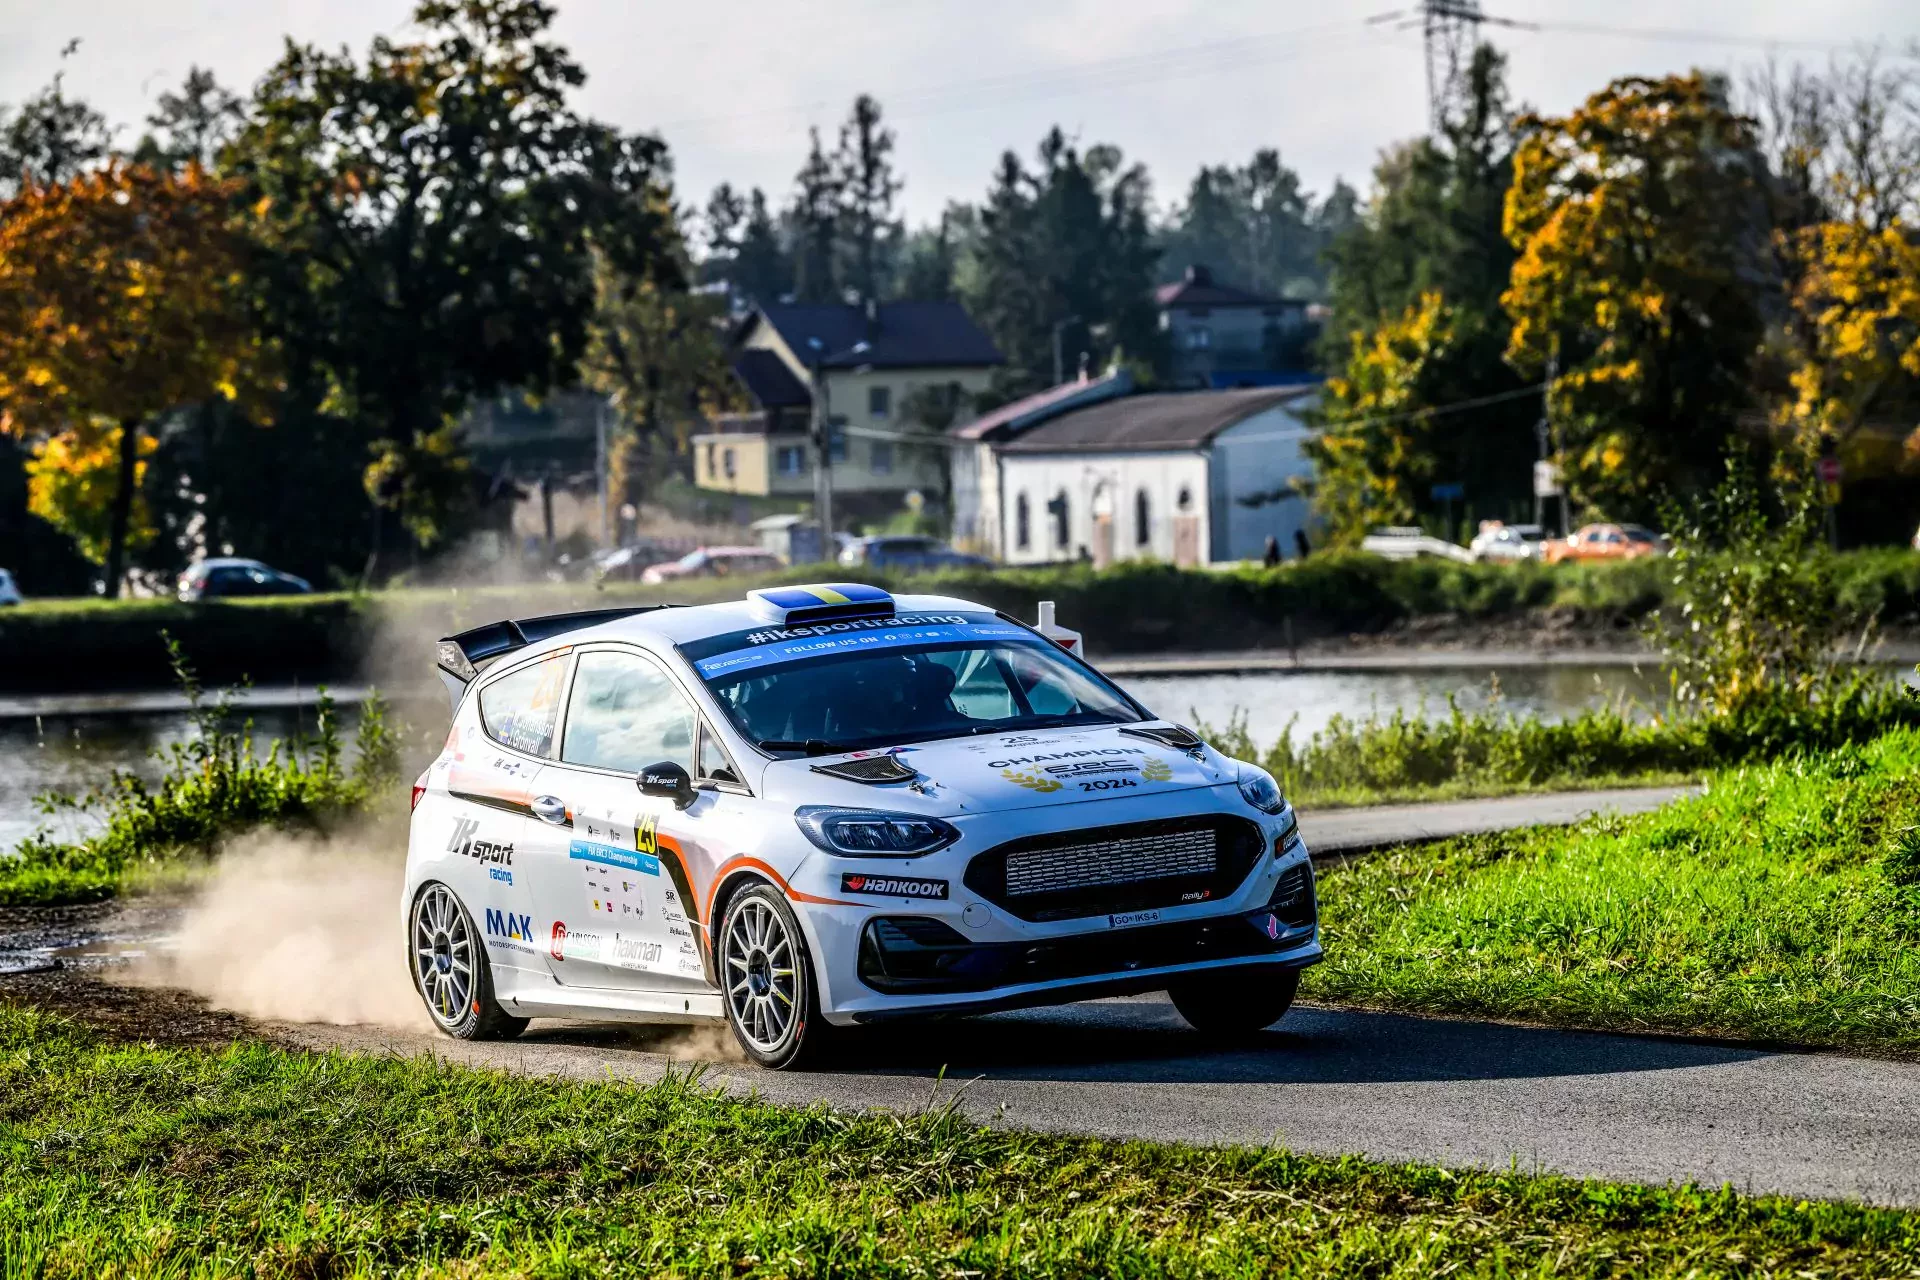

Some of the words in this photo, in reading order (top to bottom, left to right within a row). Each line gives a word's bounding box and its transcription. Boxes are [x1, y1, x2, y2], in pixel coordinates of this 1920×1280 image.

[746, 613, 969, 644] #iksportracing
[784, 641, 836, 654] FOLLOW
[839, 637, 857, 647] US
[860, 635, 879, 645] ON
[1000, 735, 1039, 744] 25
[988, 748, 1146, 768] CHAMPION
[1078, 779, 1138, 792] 2024
[471, 840, 514, 866] sport
[609, 850, 639, 867] Championship
[489, 867, 513, 887] racing
[486, 908, 534, 943] MAK
